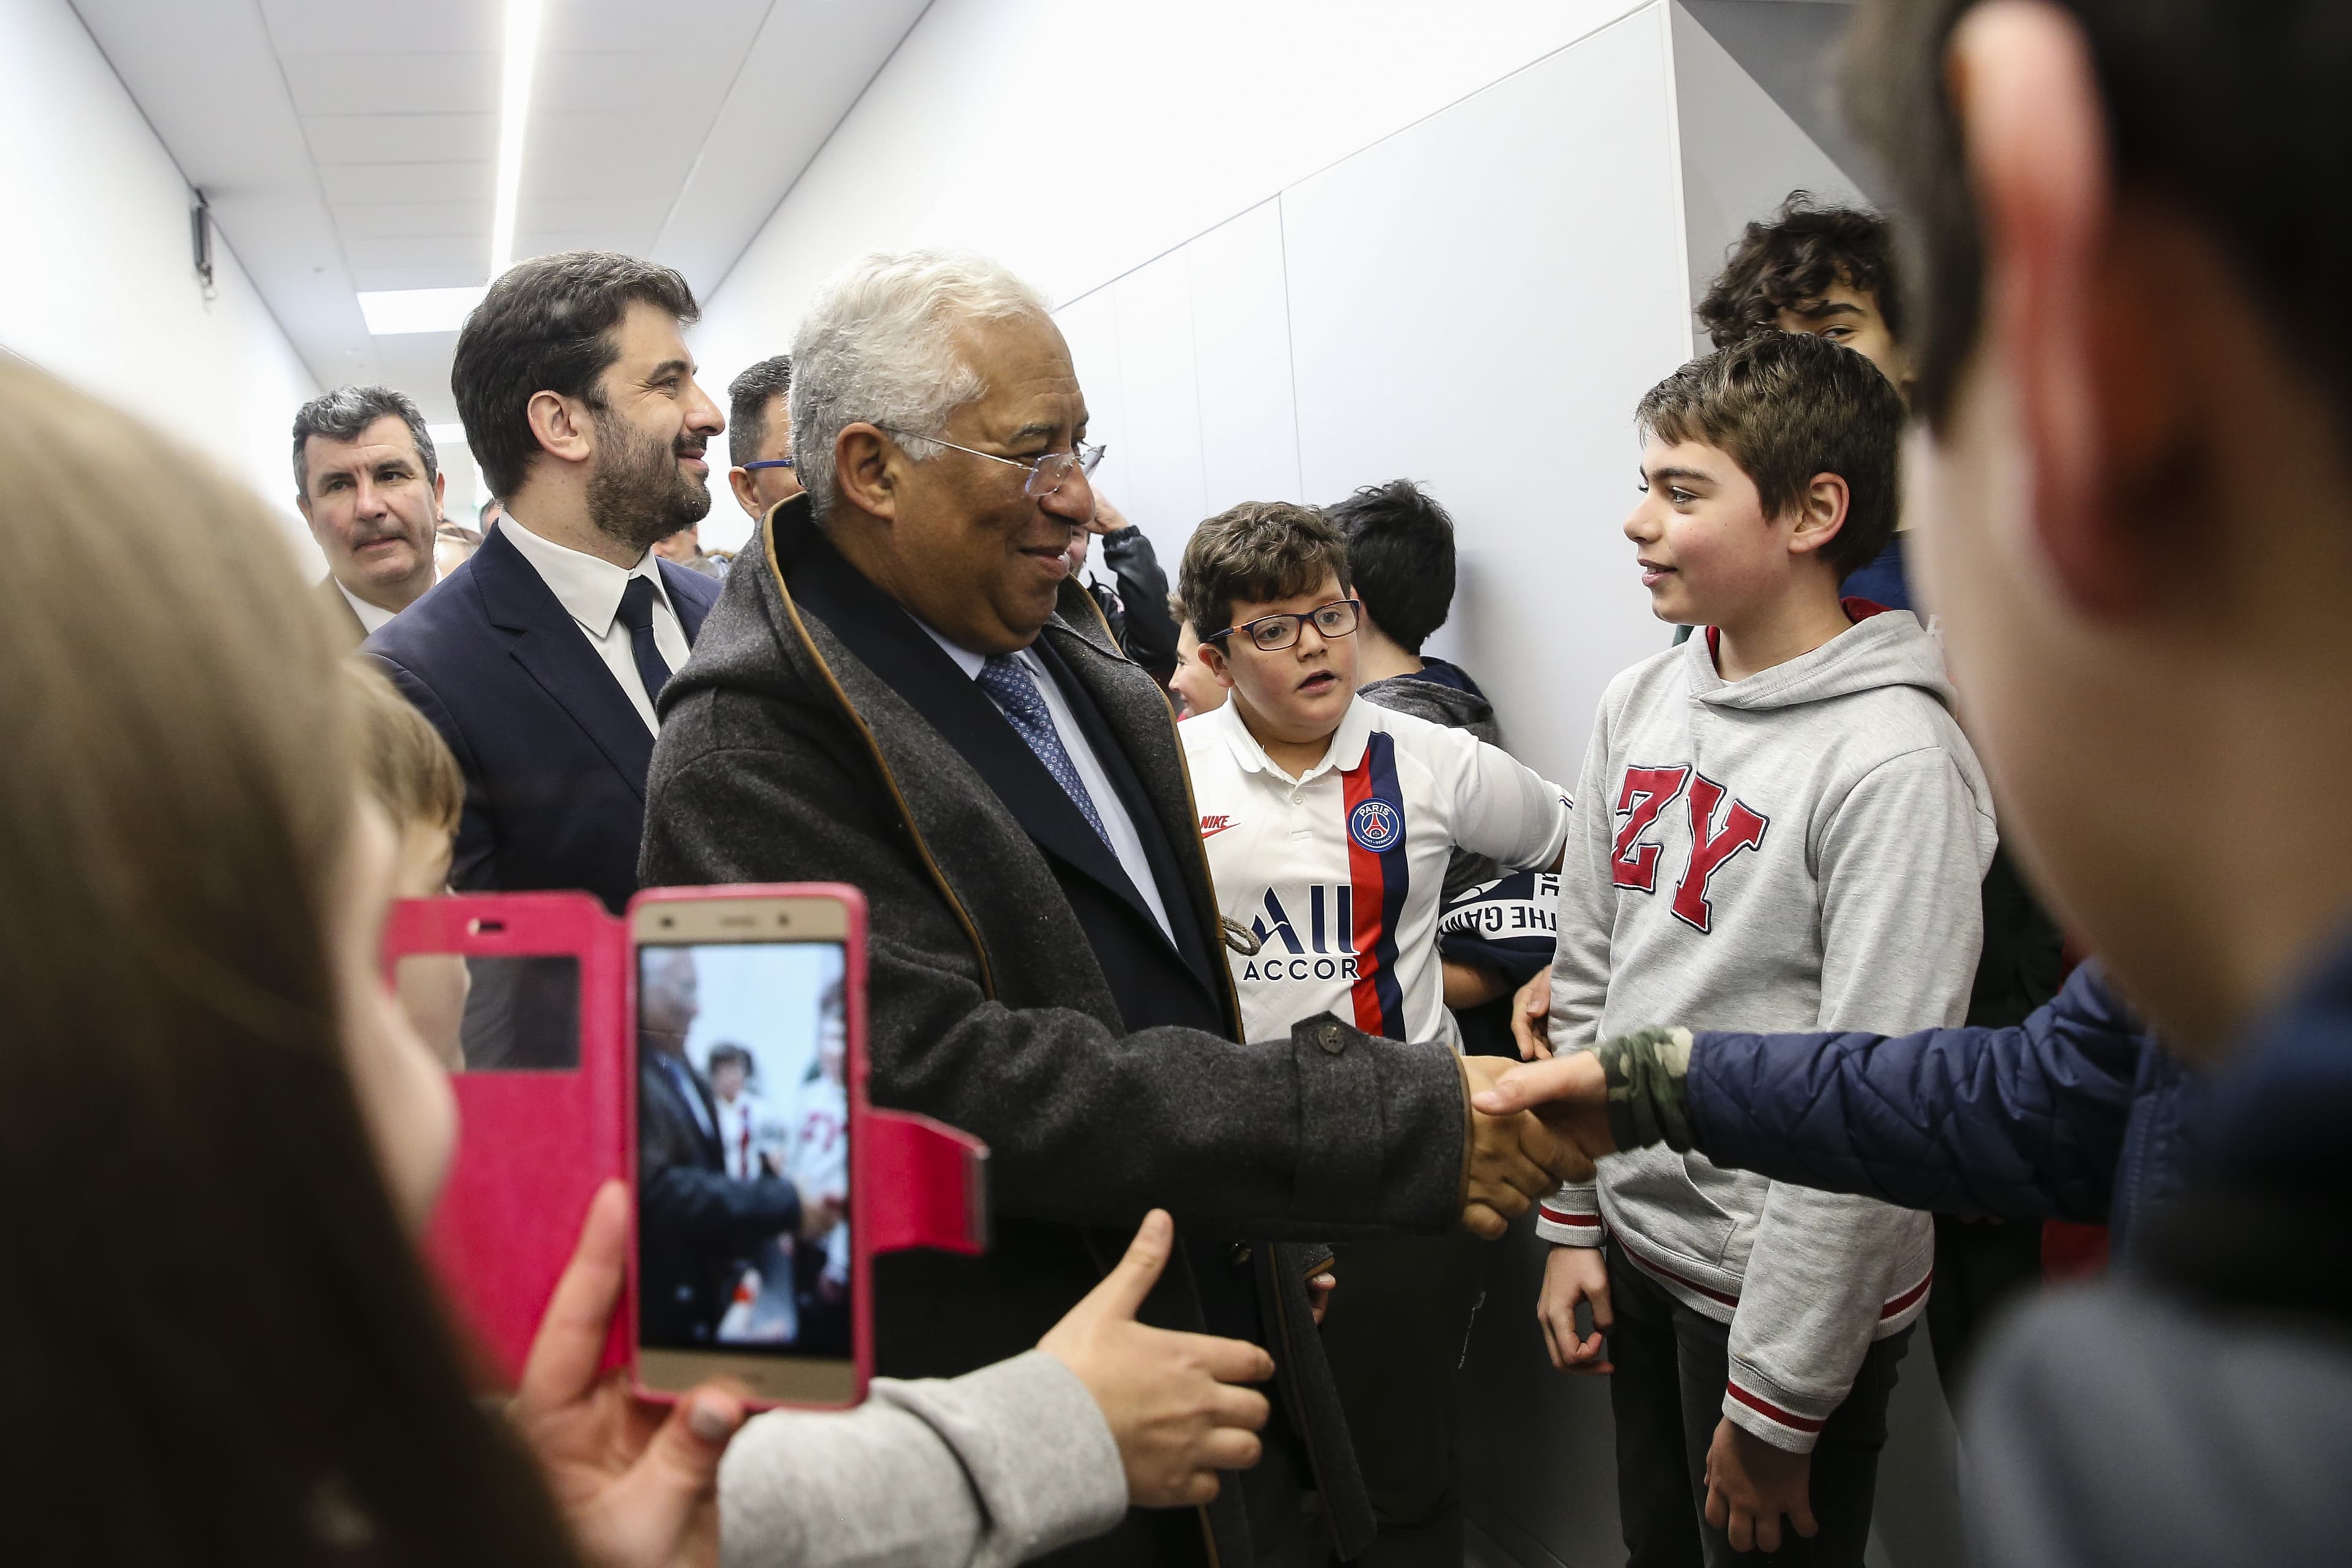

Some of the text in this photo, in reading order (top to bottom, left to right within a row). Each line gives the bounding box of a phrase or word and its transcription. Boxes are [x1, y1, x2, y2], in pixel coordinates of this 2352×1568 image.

[1200, 815, 1230, 829] NIKE
[1359, 804, 1390, 817] PARIS
[1611, 764, 1770, 935] ZY
[1510, 906, 1556, 932] THE
[1243, 958, 1359, 981] ACCOR
